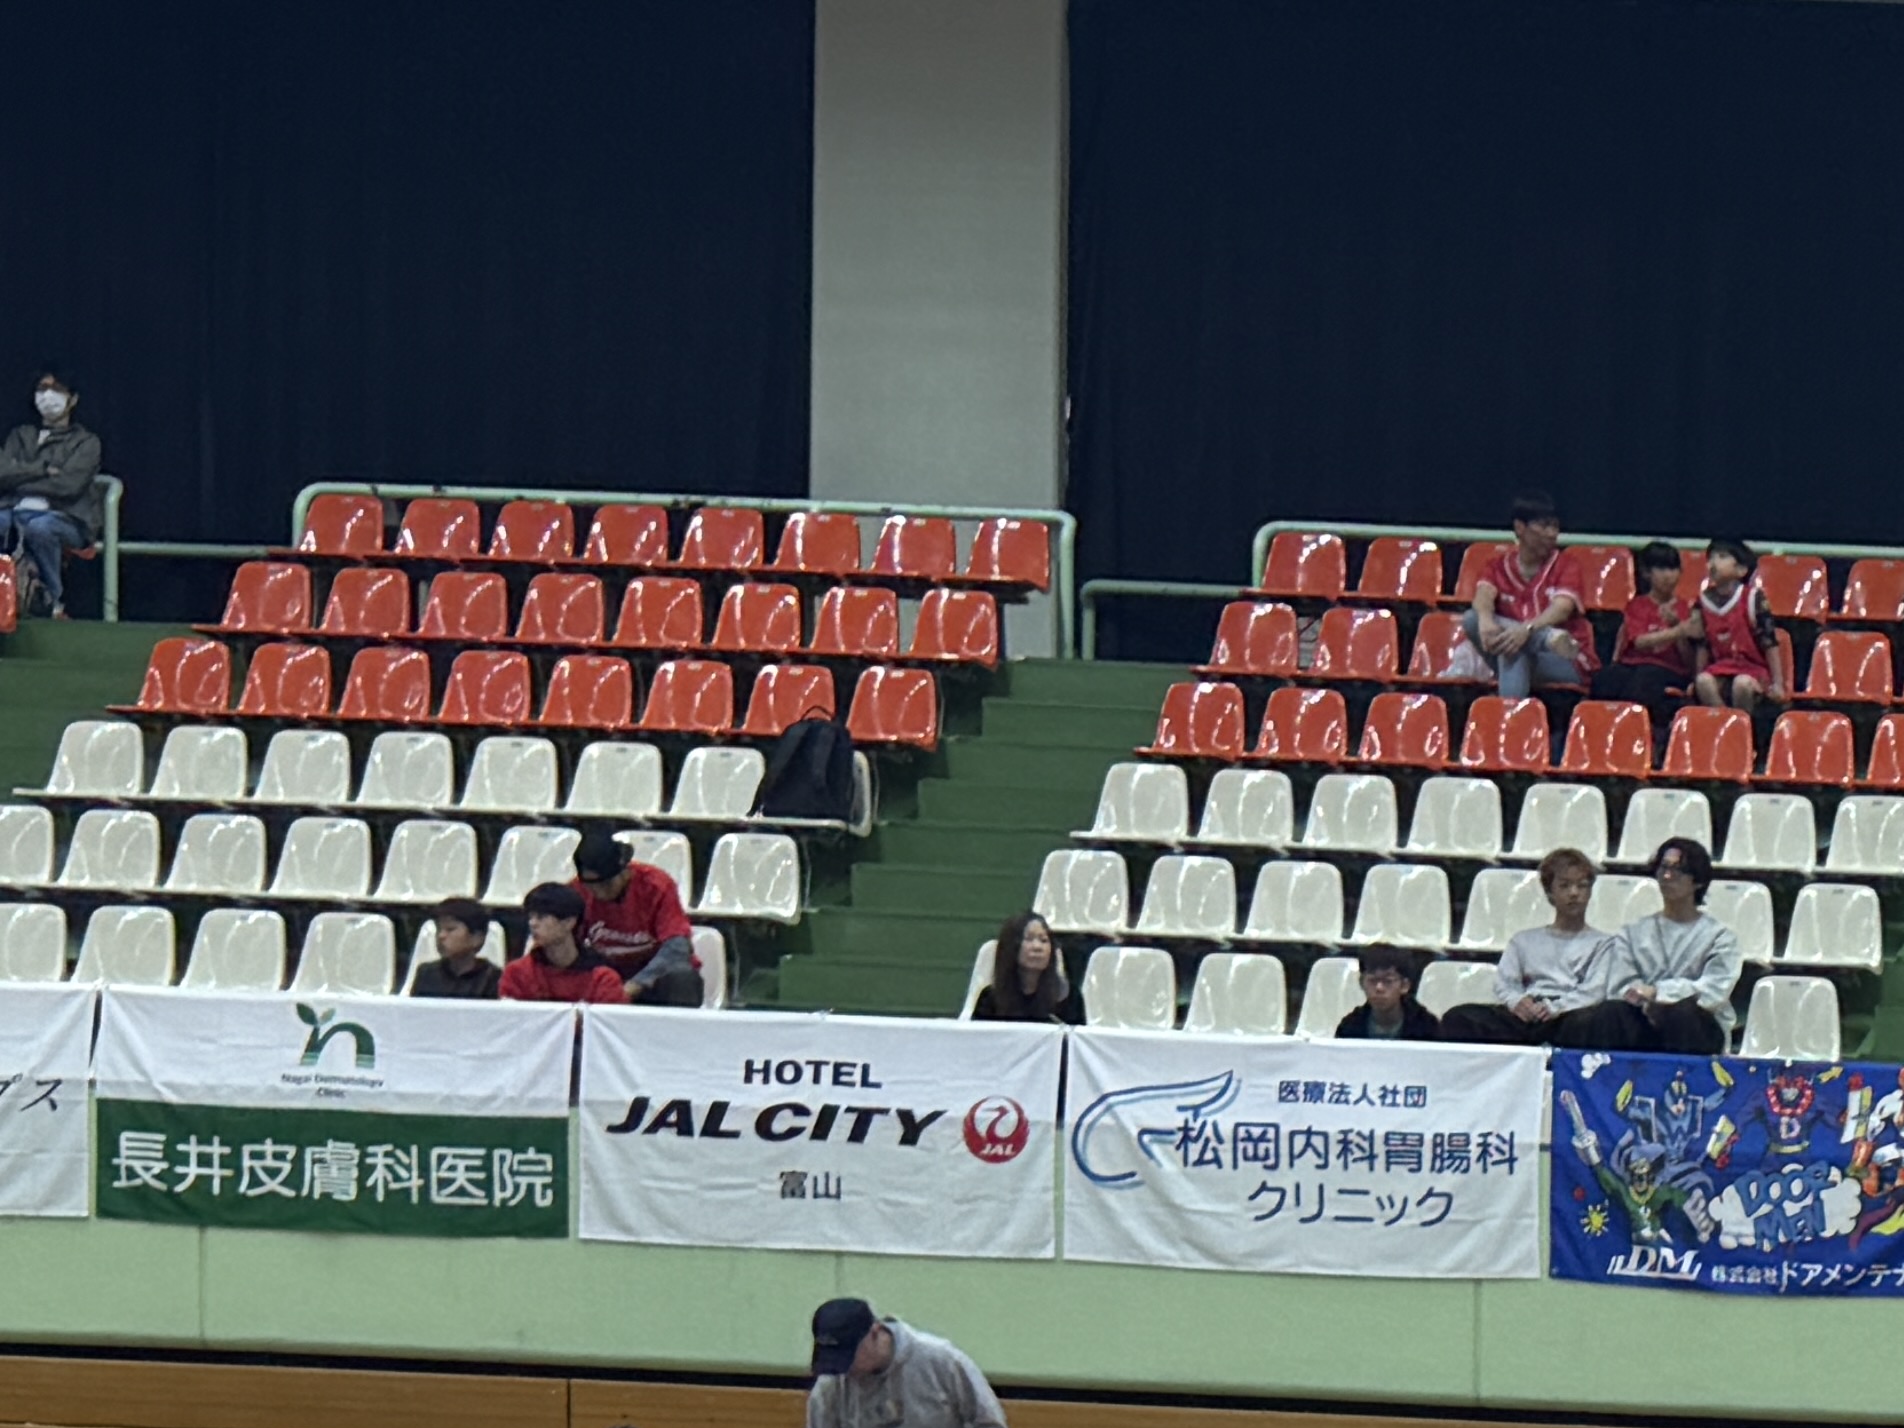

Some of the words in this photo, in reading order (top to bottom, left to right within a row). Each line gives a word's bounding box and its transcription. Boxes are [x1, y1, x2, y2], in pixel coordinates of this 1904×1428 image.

[744, 1058, 882, 1088] HOTEL
[1278, 1079, 1427, 1108] 医療法人社団
[1175, 1117, 1518, 1175] 松岡内科胃腸科
[112, 1131, 554, 1208] 長井皮膚科医院
[779, 1170, 841, 1200] 富山
[1248, 1181, 1454, 1228] クリニック
